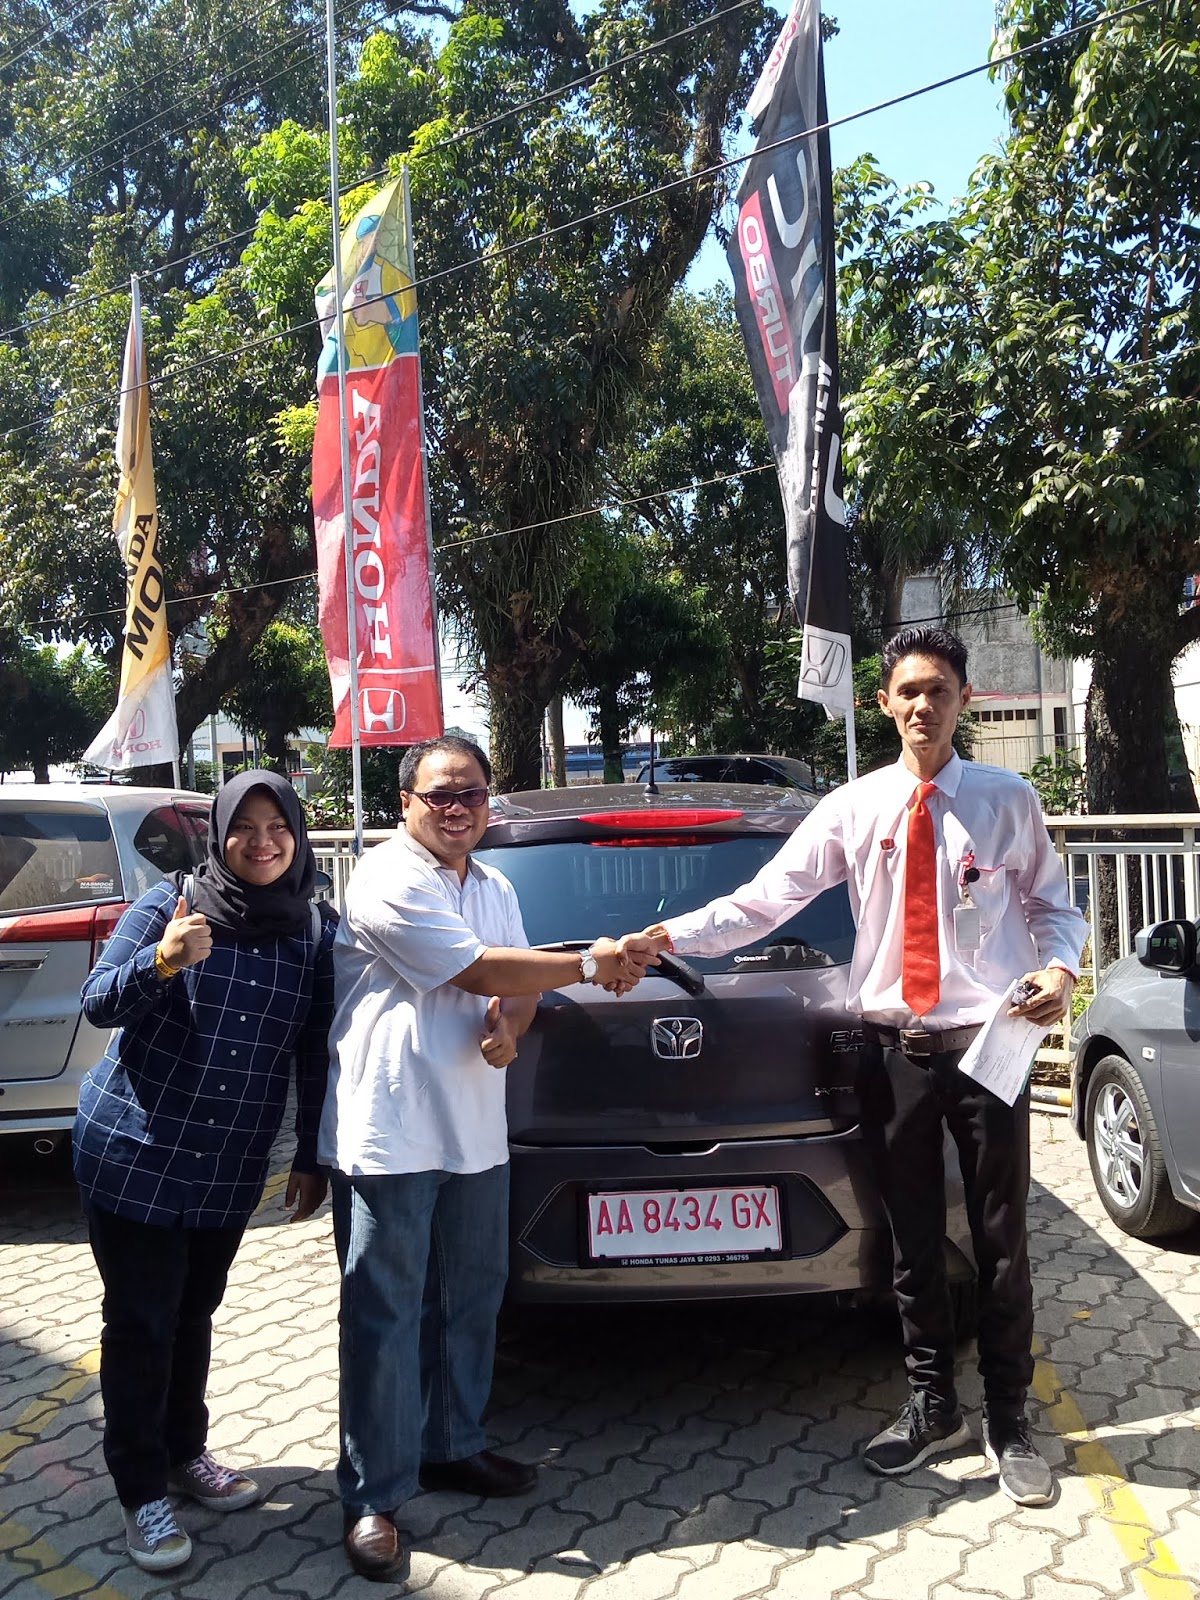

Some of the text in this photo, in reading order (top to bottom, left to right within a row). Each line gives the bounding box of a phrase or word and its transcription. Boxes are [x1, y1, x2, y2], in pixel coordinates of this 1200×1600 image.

[814, 357, 833, 434] NEW
[596, 1192, 772, 1235] AA 8434 GX
[630, 1258, 654, 1266] HONDA
